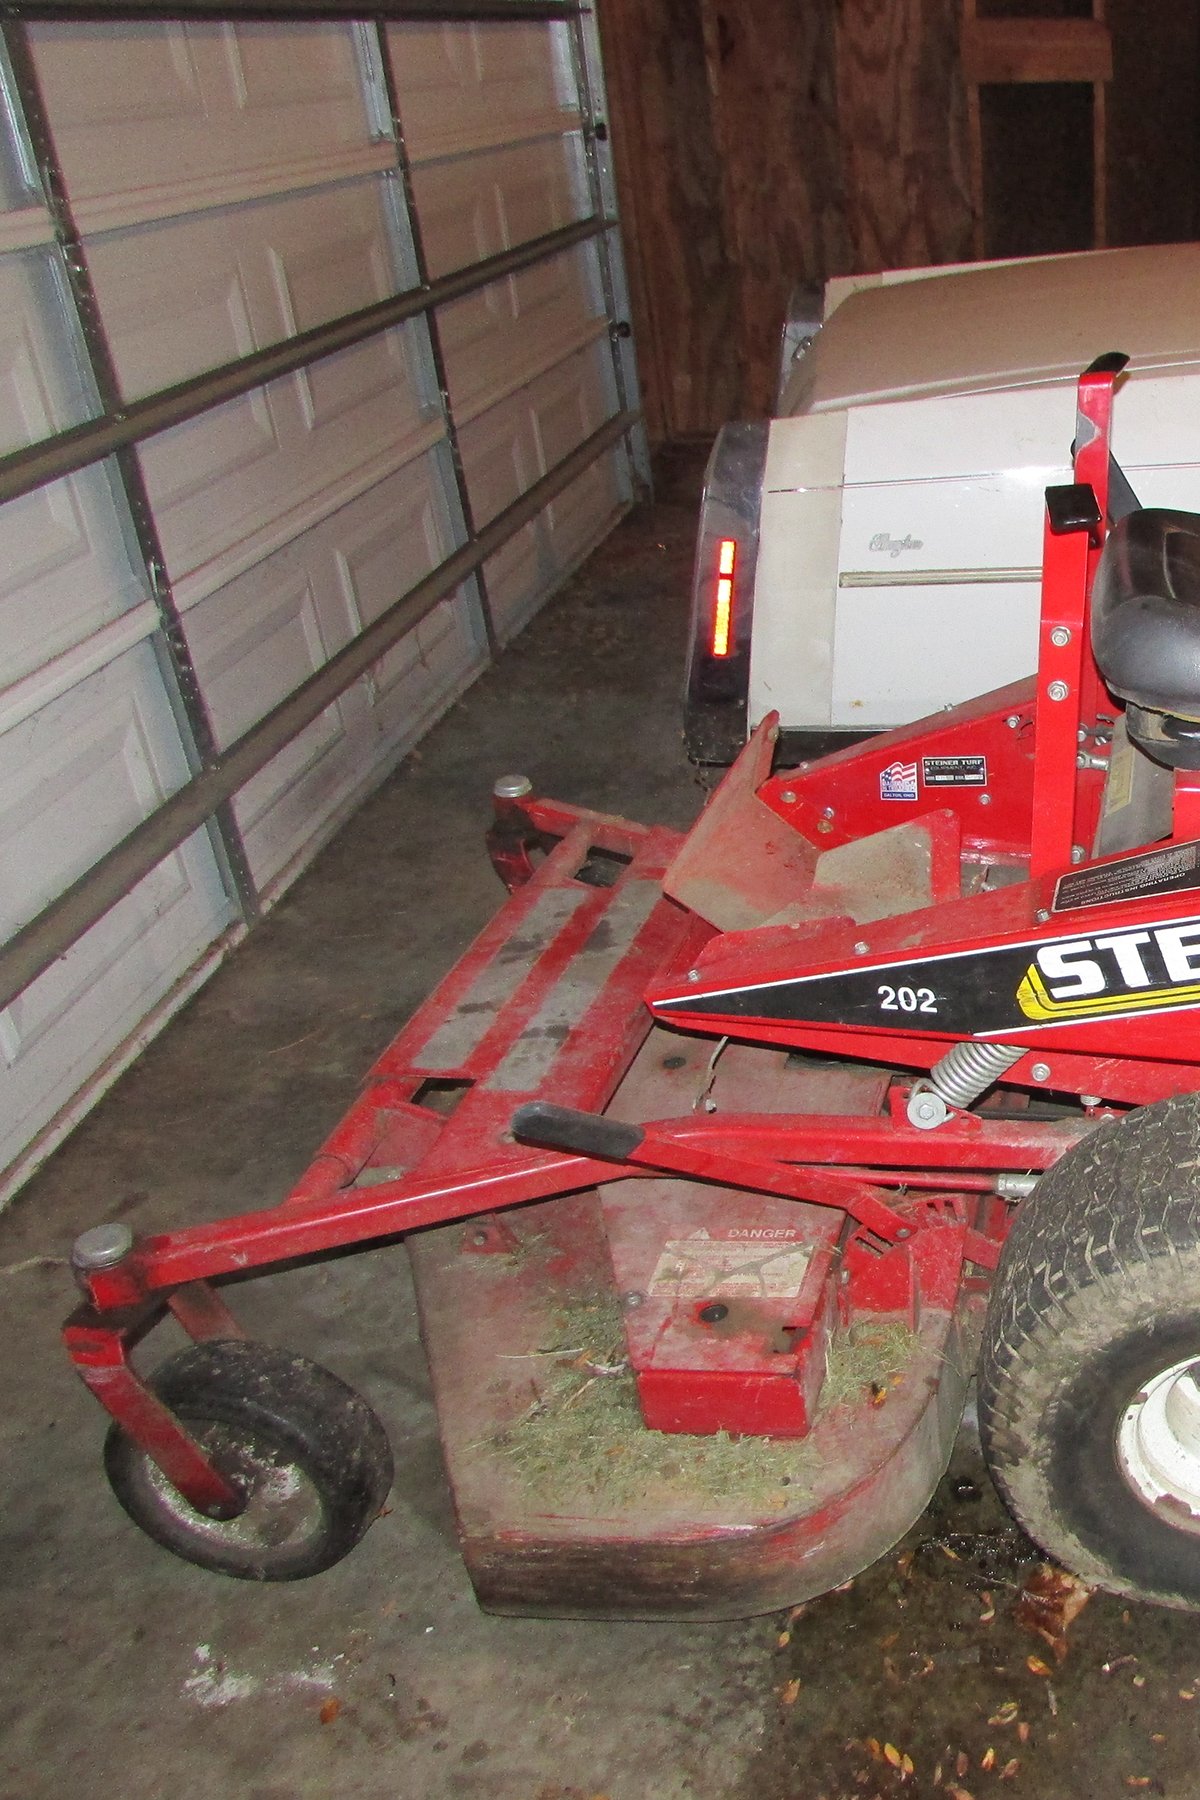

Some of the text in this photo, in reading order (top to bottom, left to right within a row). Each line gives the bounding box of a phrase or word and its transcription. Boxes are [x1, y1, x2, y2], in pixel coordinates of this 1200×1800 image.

[1080, 873, 1186, 904] OPERATING INSTRUCTIONS
[877, 985, 938, 1013] 202
[727, 1228, 798, 1239] DANGER
